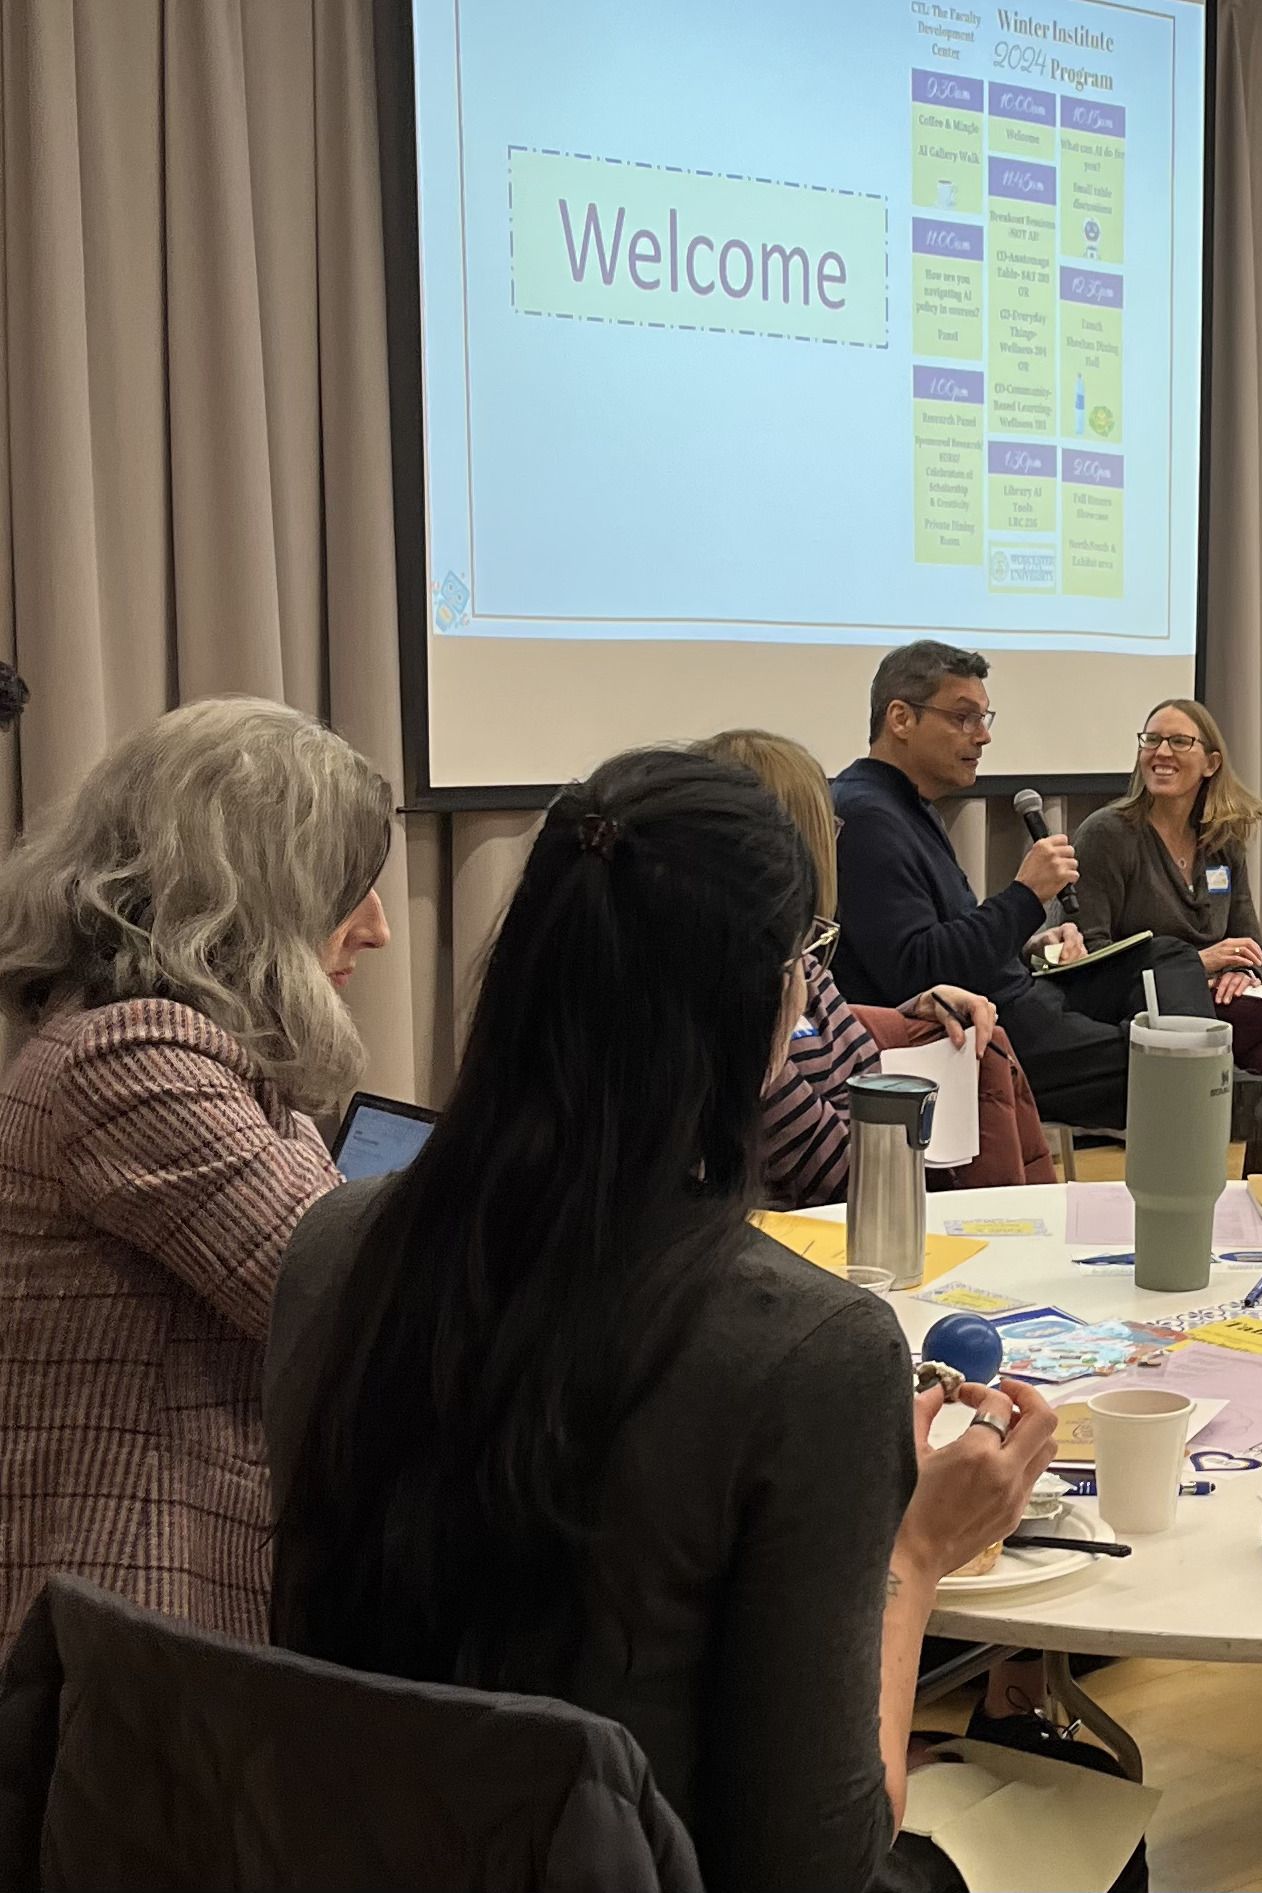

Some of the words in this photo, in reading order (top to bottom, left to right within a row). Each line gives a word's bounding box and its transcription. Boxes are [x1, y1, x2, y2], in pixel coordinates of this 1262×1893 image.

[932, 4, 948, 18] The
[950, 8, 981, 28] Faculty
[918, 21, 974, 41] Development
[997, 8, 1049, 40] Winter
[1052, 20, 1114, 52] Institute
[932, 43, 960, 60] Center
[993, 41, 1047, 75] 2024
[1050, 59, 1113, 92] Program
[919, 115, 943, 128] Coffee
[953, 120, 979, 135] Mingle
[1005, 128, 1040, 144] Welcome
[918, 145, 927, 156] AI
[929, 146, 957, 162] Gallery
[959, 151, 980, 164] Walk
[558, 198, 847, 309] Welcome
[938, 329, 959, 341] Panel
[1003, 486, 1032, 499] Library
[1033, 487, 1042, 497] AI
[1013, 503, 1033, 513] Tools
